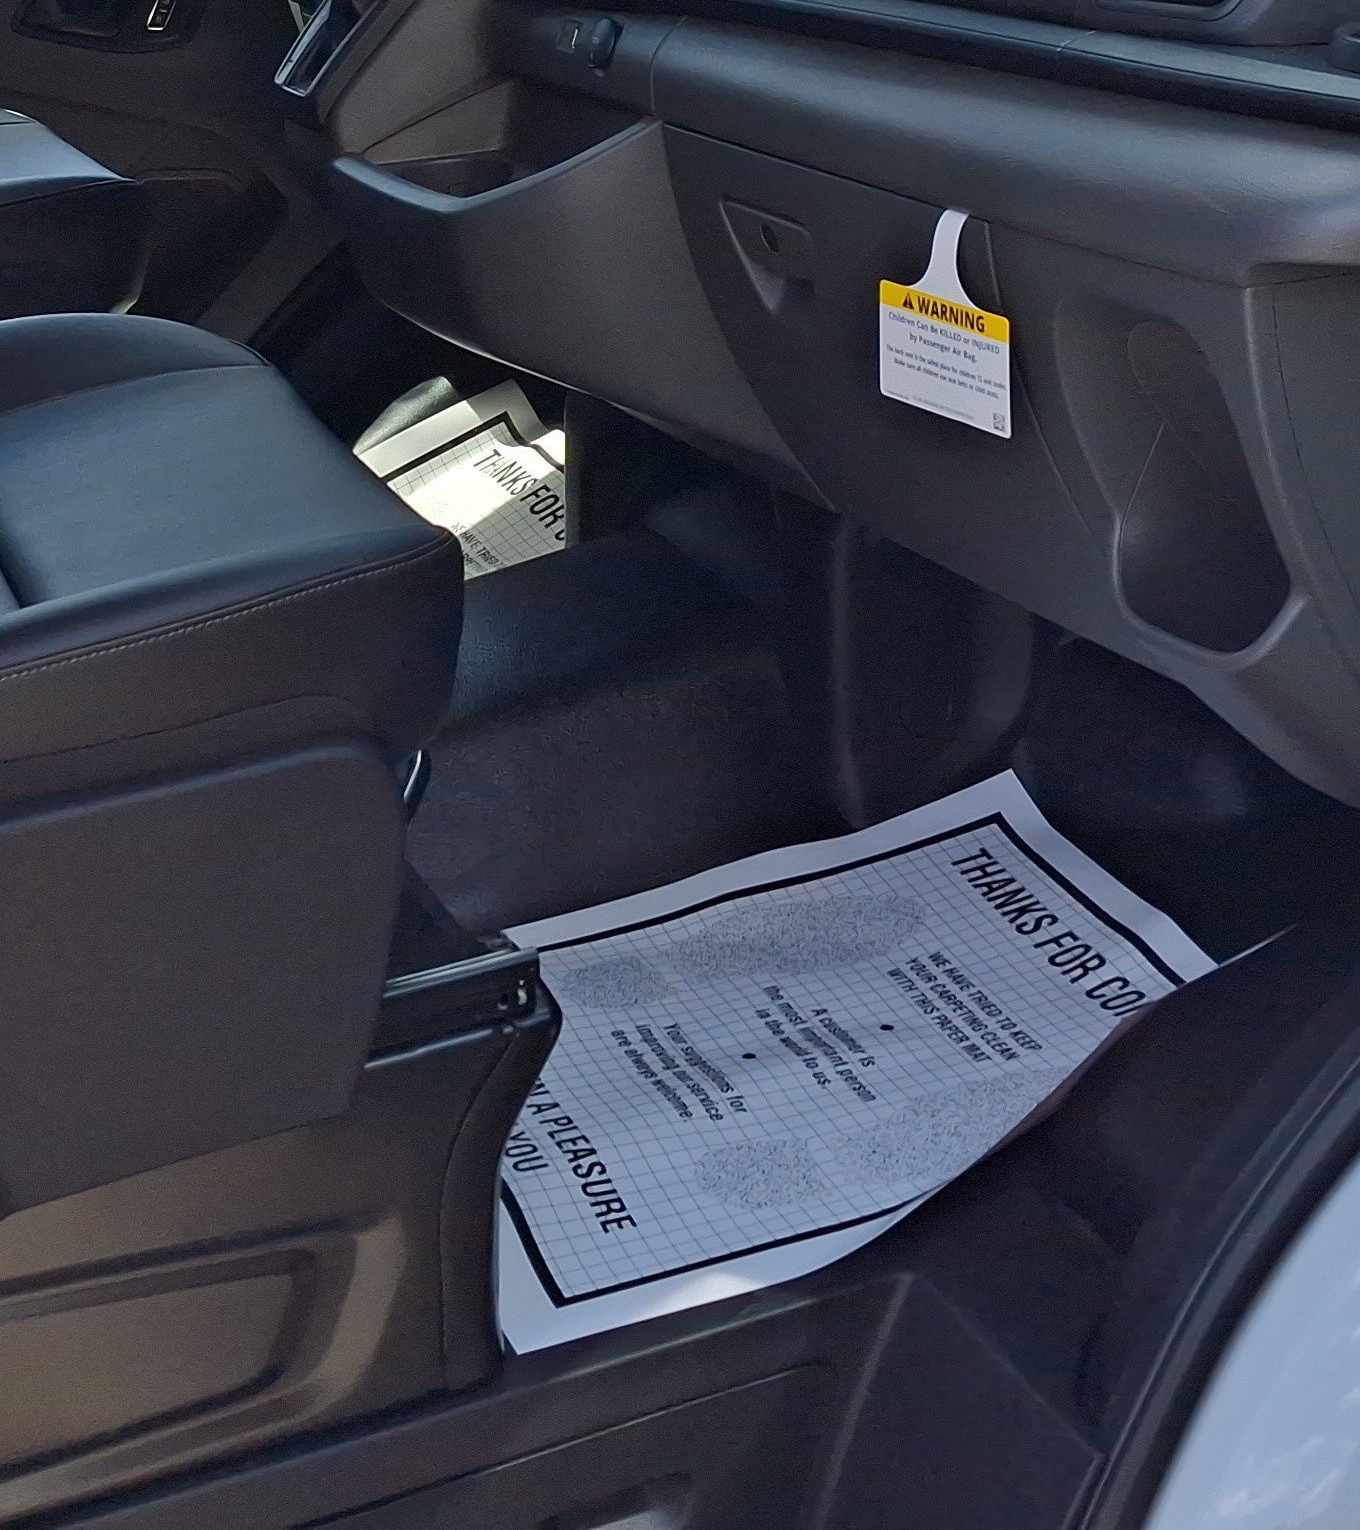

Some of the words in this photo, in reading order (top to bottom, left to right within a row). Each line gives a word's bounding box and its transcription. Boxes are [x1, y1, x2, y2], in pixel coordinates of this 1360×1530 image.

[889, 312, 915, 327] Children
[916, 320, 928, 331] Can
[940, 329, 961, 342] KILLED
[972, 339, 1000, 354] INJURED
[917, 296, 985, 333] WARNING
[909, 332, 917, 343] by
[919, 335, 950, 353] Passenger
[952, 347, 961, 356] Air
[950, 847, 1059, 935] THANKS
[1033, 930, 1107, 984] FOR
[1085, 976, 1146, 1017] CO
[887, 967, 919, 993] WITH
[911, 992, 940, 1015] THIS
[931, 1013, 970, 1045] PAPER
[961, 1043, 993, 1063] MAT
[905, 956, 938, 984] YOUR
[929, 983, 989, 1033] CARPETING
[980, 1031, 1021, 1061] CLEAN
[928, 952, 952, 968] WE
[942, 966, 976, 992] HAVE
[967, 990, 1003, 1018] TRIED
[995, 1016, 1018, 1031] TO
[1008, 1029, 1043, 1051] KEEP
[611, 1030, 632, 1047] are
[624, 1049, 658, 1079] always
[778, 1002, 808, 1026] most
[835, 1069, 876, 1102] person
[802, 1057, 819, 1069] to
[811, 1008, 828, 1017] A
[858, 1056, 875, 1067] is
[664, 1023, 687, 1044] Your
[726, 1095, 747, 1113] for
[526, 1102, 560, 1115] A
[686, 1083, 723, 1121] service
[505, 1131, 550, 1172] YOU
[538, 1115, 637, 1234] PLEASURE
